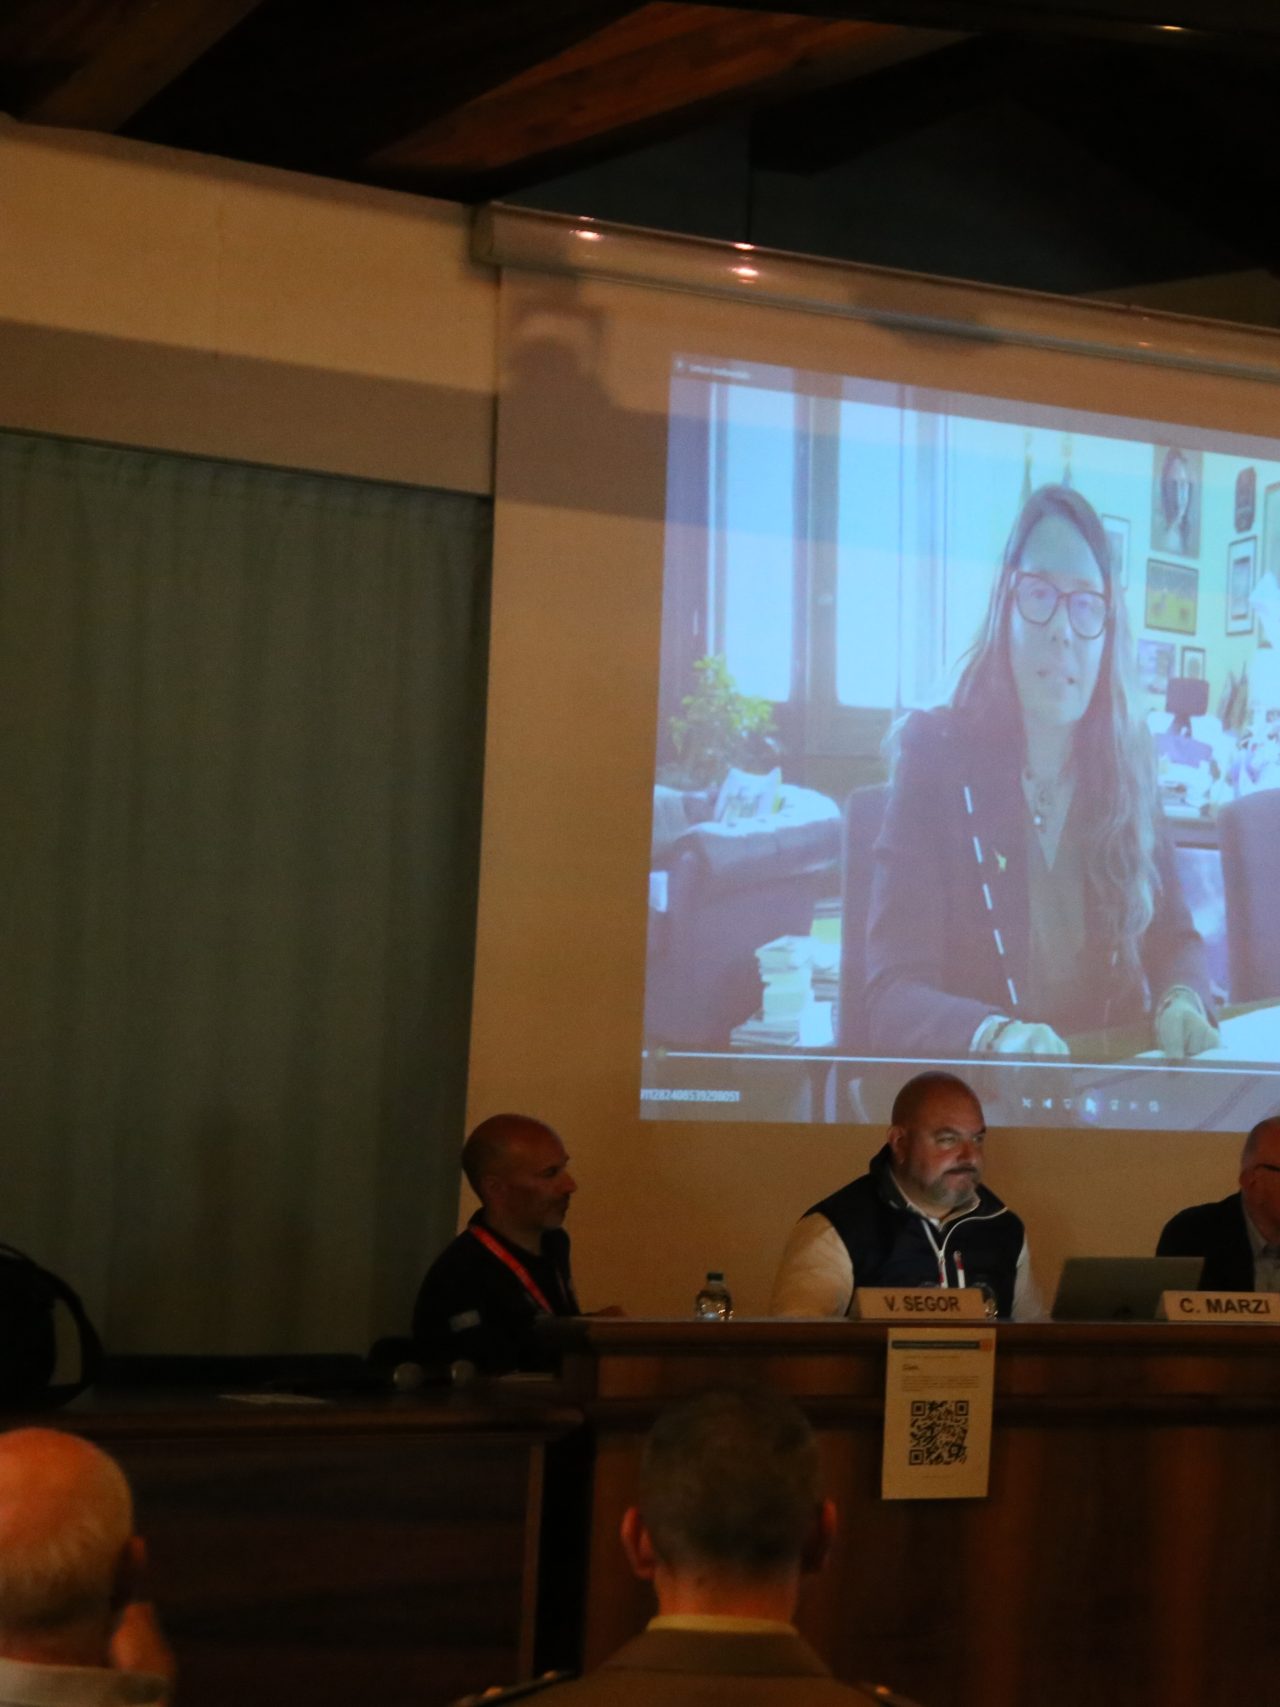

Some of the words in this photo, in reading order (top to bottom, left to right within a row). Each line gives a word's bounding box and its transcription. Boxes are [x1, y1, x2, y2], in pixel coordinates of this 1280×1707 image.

[884, 1296, 900, 1312] V.
[903, 1296, 961, 1312] SEGOR
[1179, 1297, 1200, 1313] C.
[1205, 1298, 1270, 1313] MARZI
